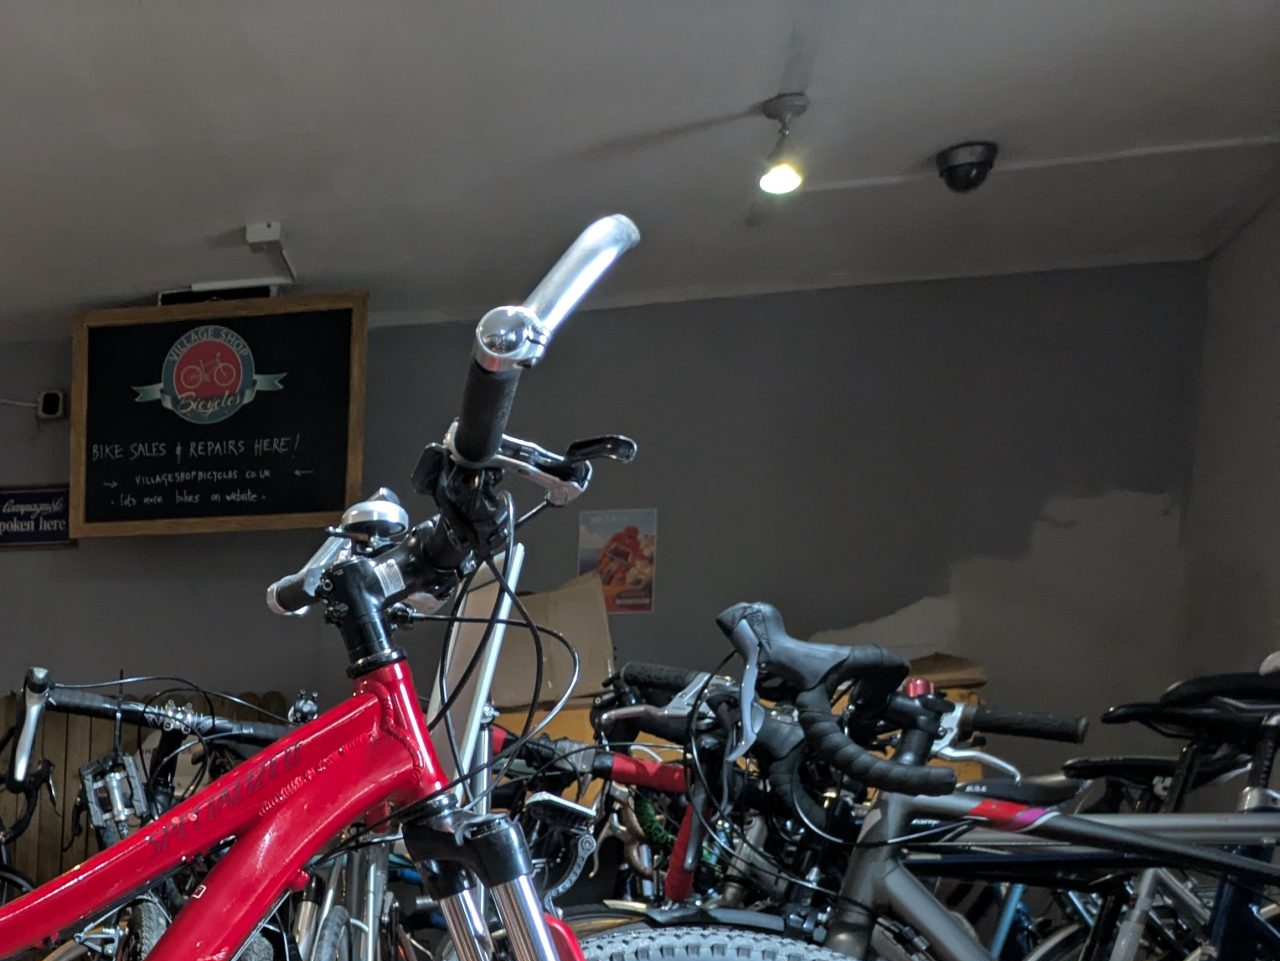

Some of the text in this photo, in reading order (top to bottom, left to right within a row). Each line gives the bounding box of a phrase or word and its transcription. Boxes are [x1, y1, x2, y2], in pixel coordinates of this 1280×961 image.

[169, 328, 249, 361] VILLAGE SHOP
[92, 443, 123, 462] BIKE
[129, 442, 167, 461] SALES
[190, 440, 245, 457] REPAIRS
[175, 489, 200, 504] bikes
[211, 494, 221, 502] on
[226, 491, 257, 502] website
[39, 517, 66, 531] here
